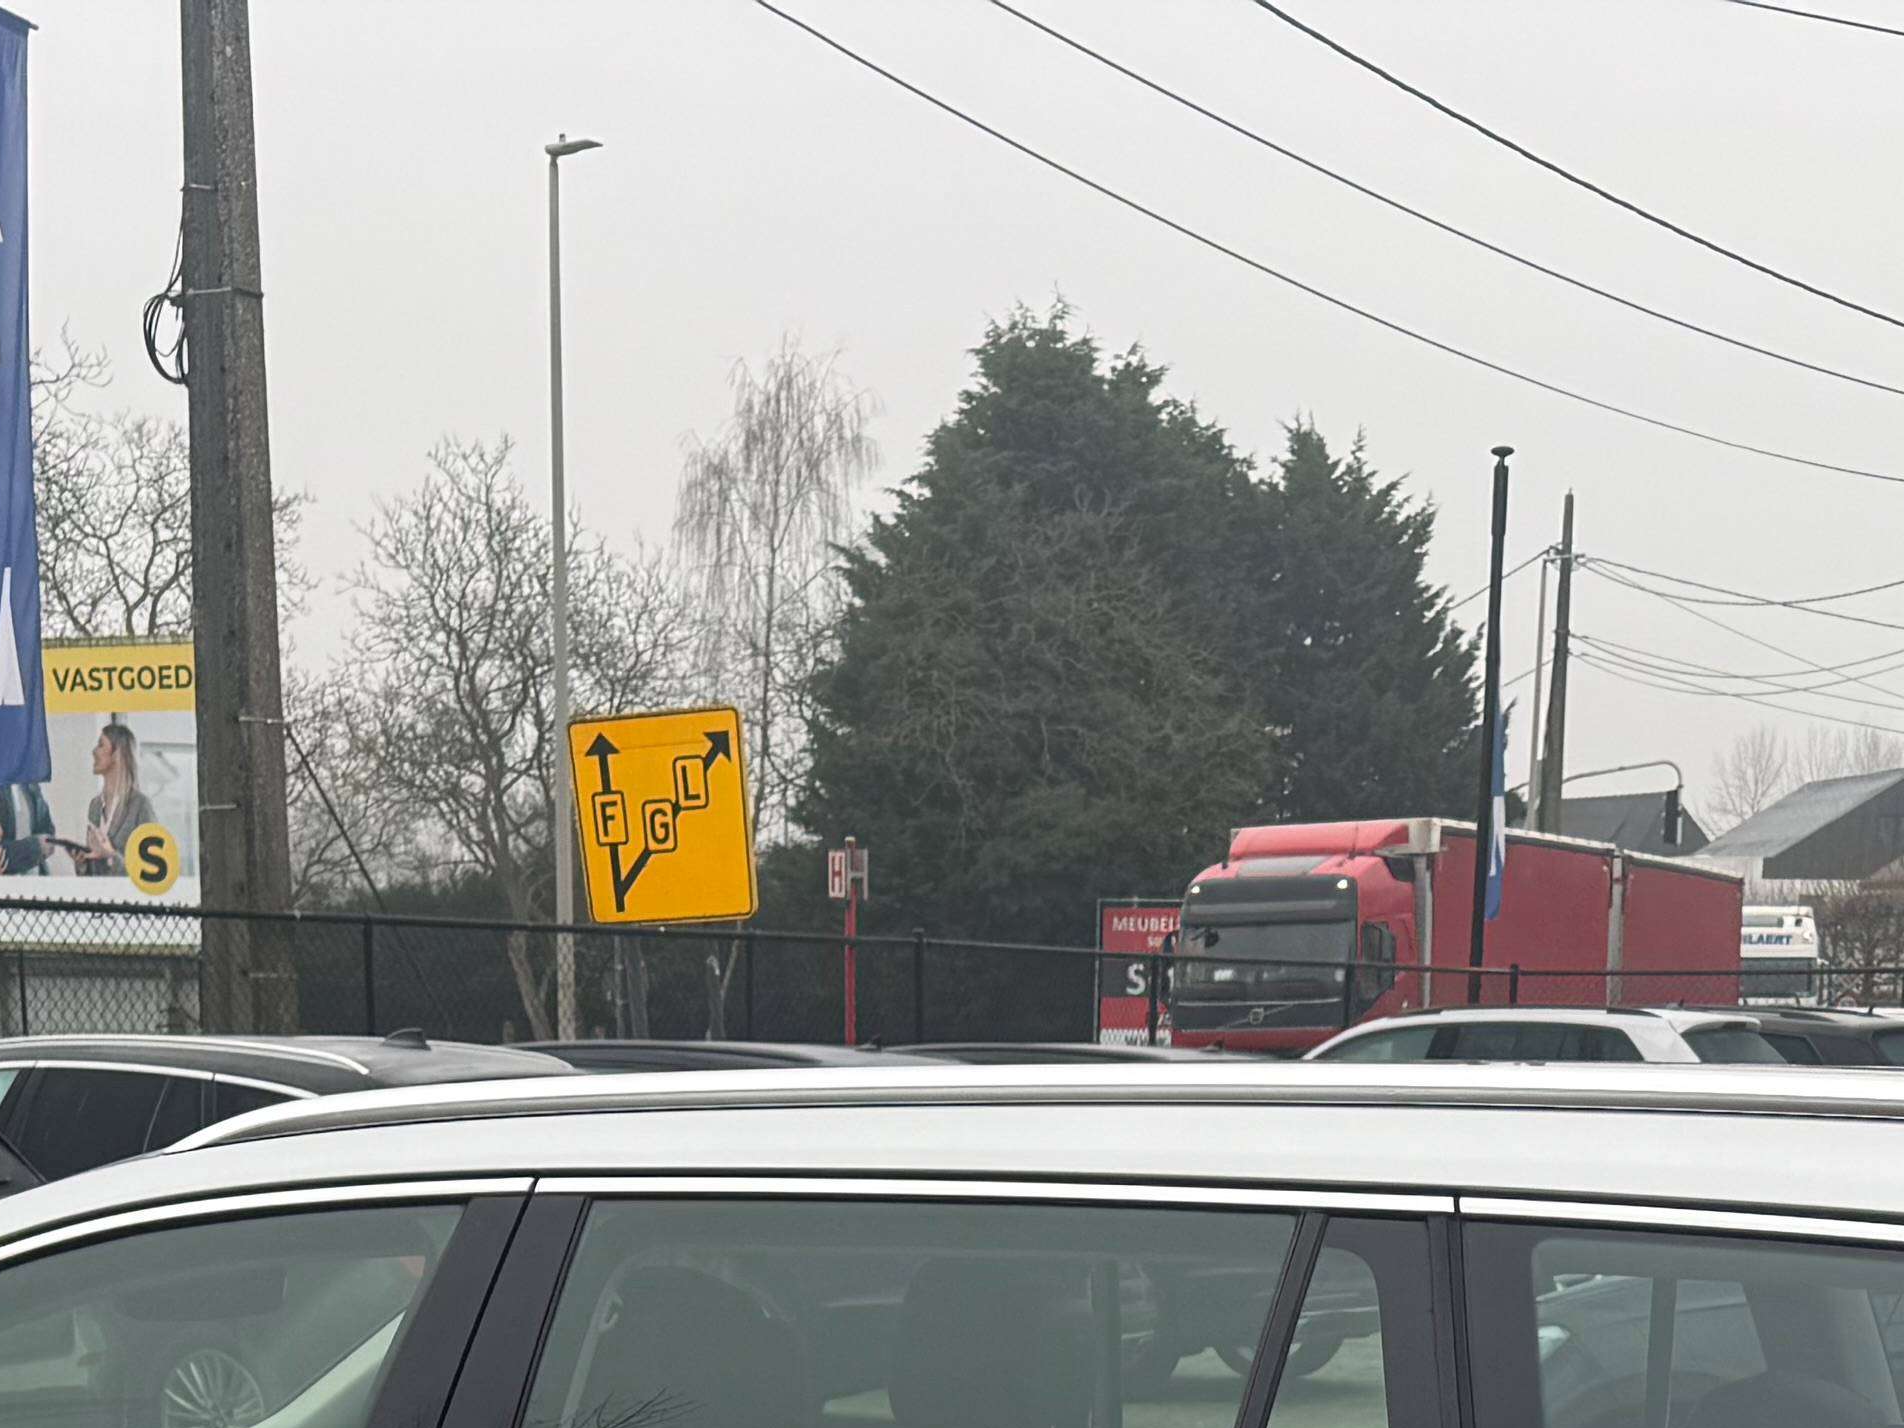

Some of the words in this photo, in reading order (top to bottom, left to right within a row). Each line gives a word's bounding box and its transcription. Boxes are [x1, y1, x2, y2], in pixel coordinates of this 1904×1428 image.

[52, 664, 193, 692] VASTGOED
[681, 765, 701, 801] L
[601, 801, 618, 838] F
[649, 808, 670, 844] G
[137, 836, 168, 883] S
[831, 855, 843, 893] H
